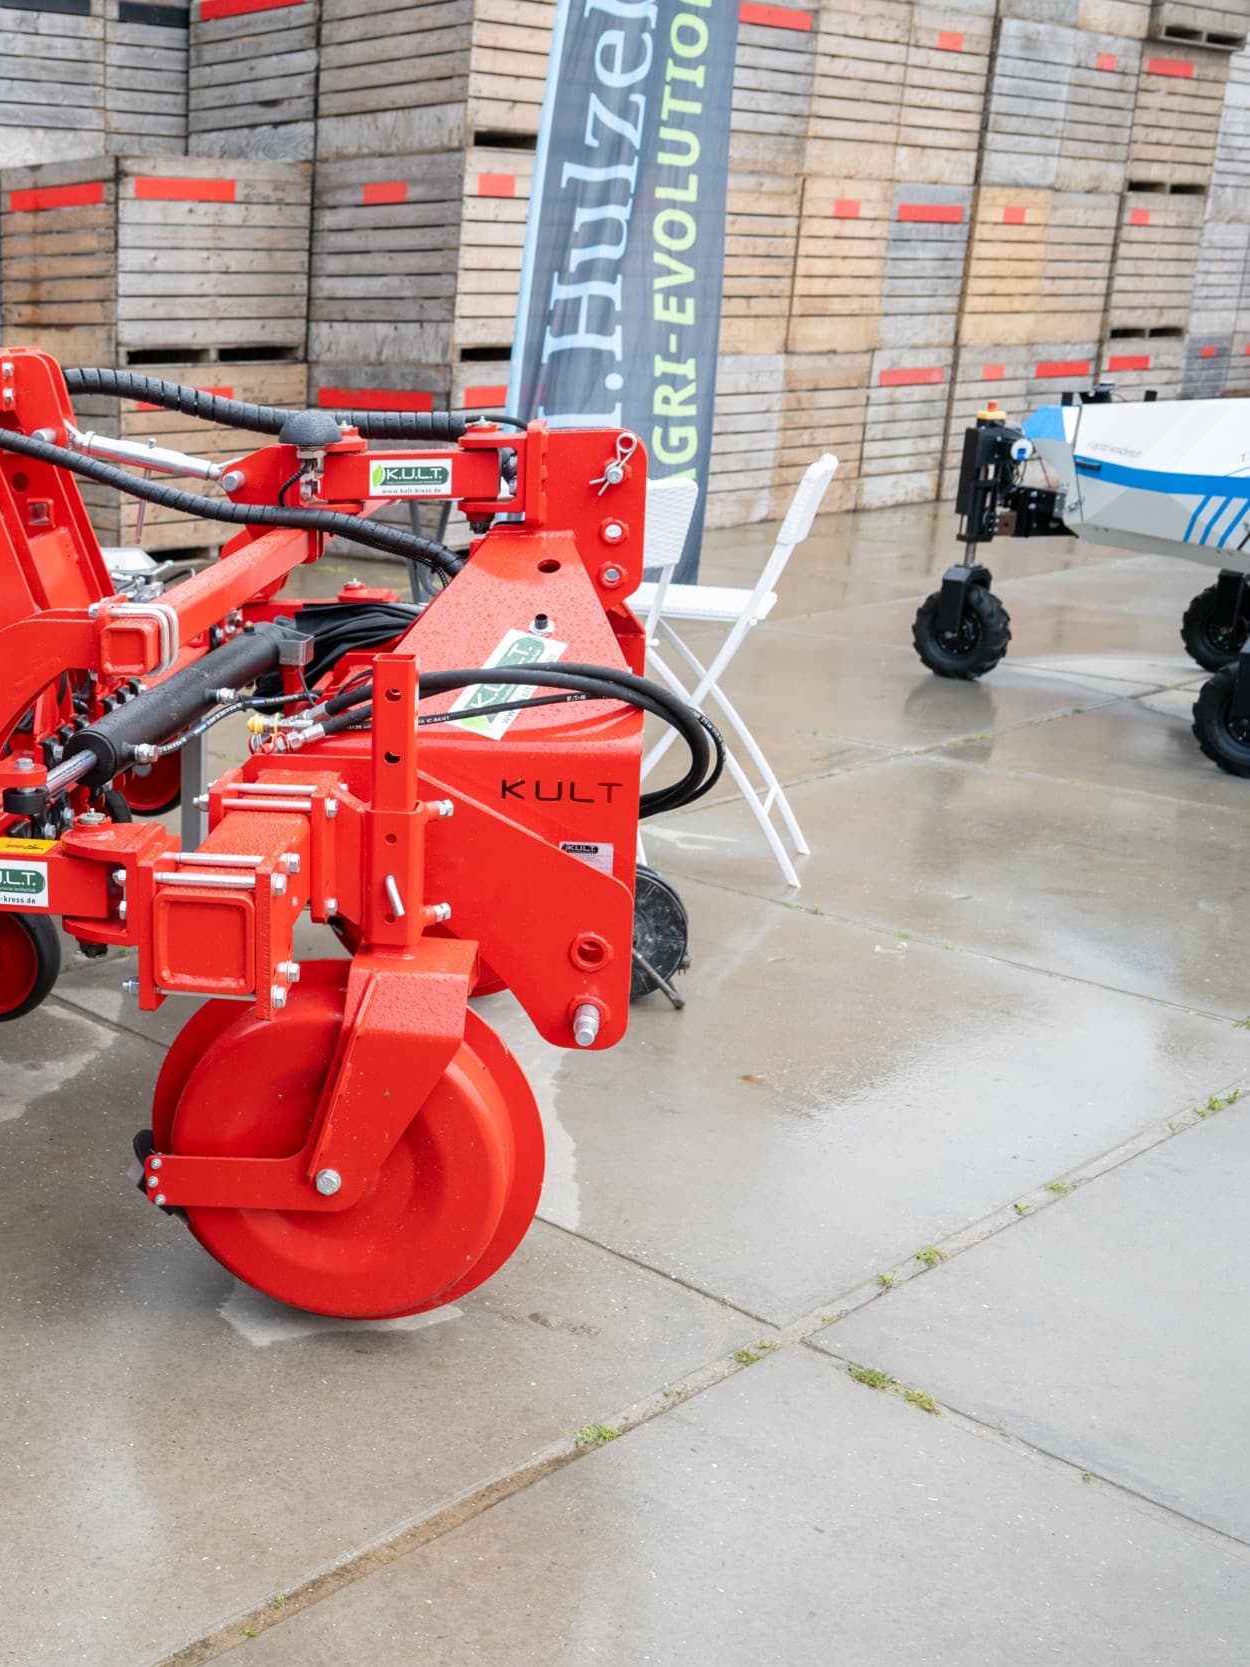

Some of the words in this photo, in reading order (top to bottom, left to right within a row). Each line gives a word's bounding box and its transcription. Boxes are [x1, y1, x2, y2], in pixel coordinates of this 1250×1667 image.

[652, 0, 712, 480] GRI-EVOLUTIO
[386, 467, 442, 480] K.U.L.T.
[502, 779, 622, 803] KULT
